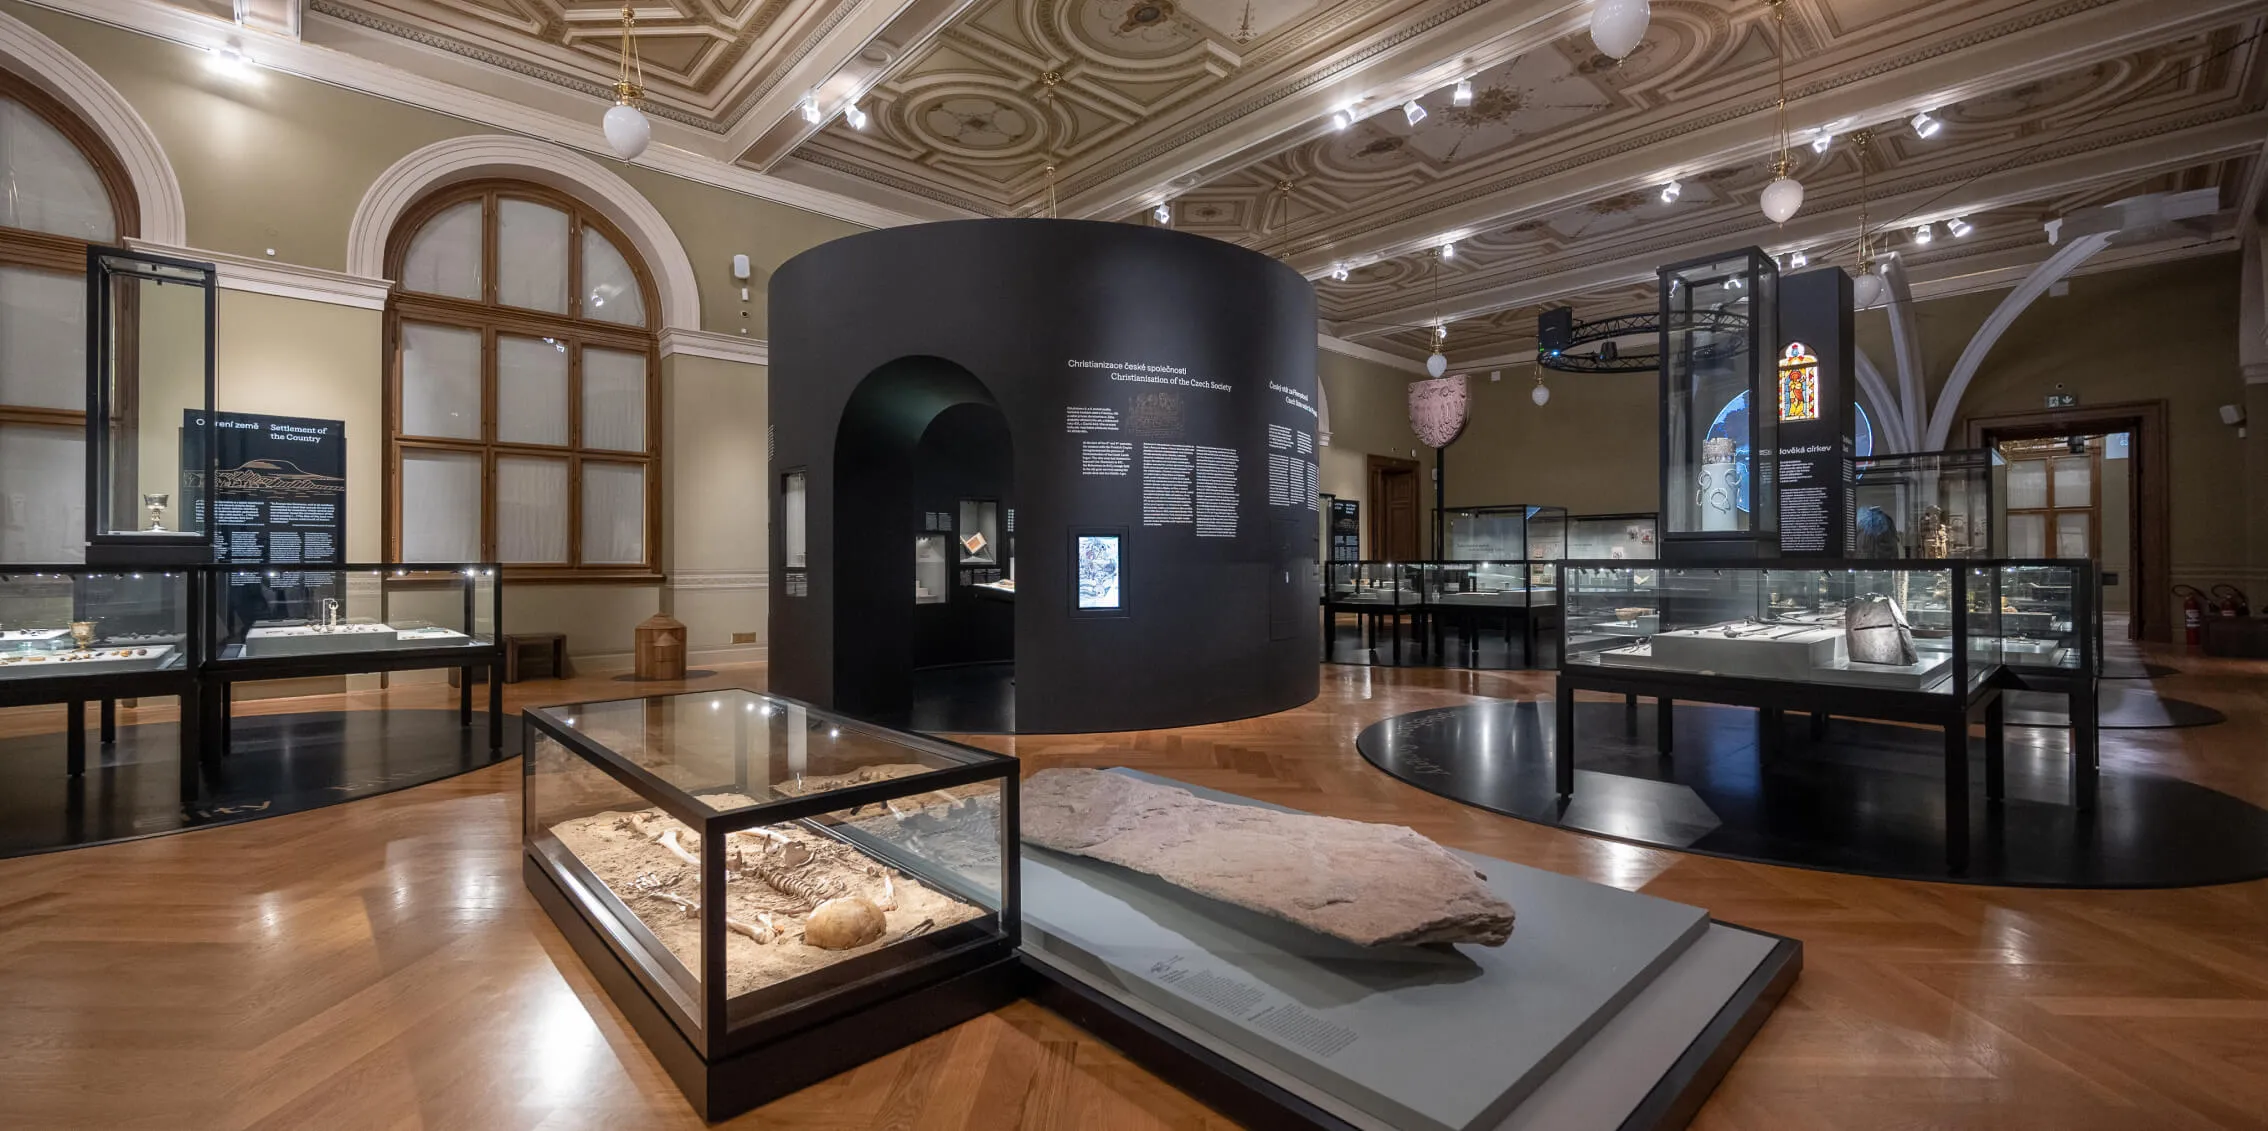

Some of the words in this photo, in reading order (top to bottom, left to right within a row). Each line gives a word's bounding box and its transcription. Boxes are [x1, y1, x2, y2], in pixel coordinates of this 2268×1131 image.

[1067, 359, 1123, 370] Christianizace
[1110, 372, 1169, 384] Christianisation
[1170, 376, 1178, 385] of
[1178, 378, 1190, 386] the
[1190, 378, 1210, 389] Czech
[1210, 381, 1232, 393] Society
[270, 423, 316, 434] Settlement
[316, 427, 328, 435] of
[286, 433, 321, 443] Country
